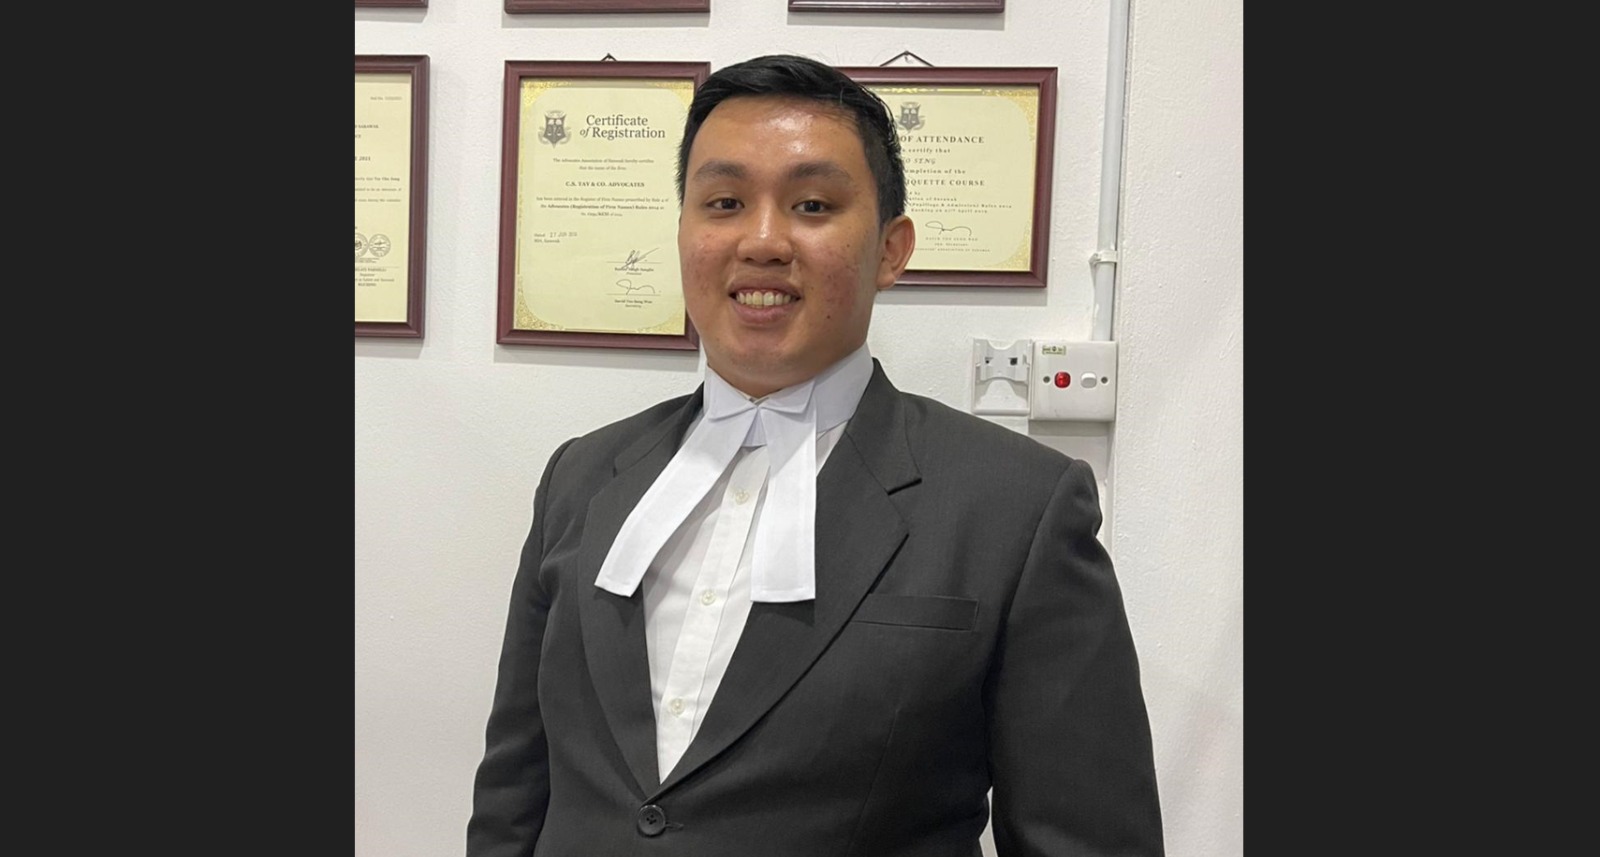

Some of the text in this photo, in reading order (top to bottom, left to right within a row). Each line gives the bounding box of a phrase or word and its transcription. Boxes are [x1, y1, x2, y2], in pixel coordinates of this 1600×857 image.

[586, 114, 648, 126] Certificate
[580, 127, 666, 140] of Registration
[900, 135, 985, 144] OF ATTENDANCE
[949, 179, 985, 187] COURSE
